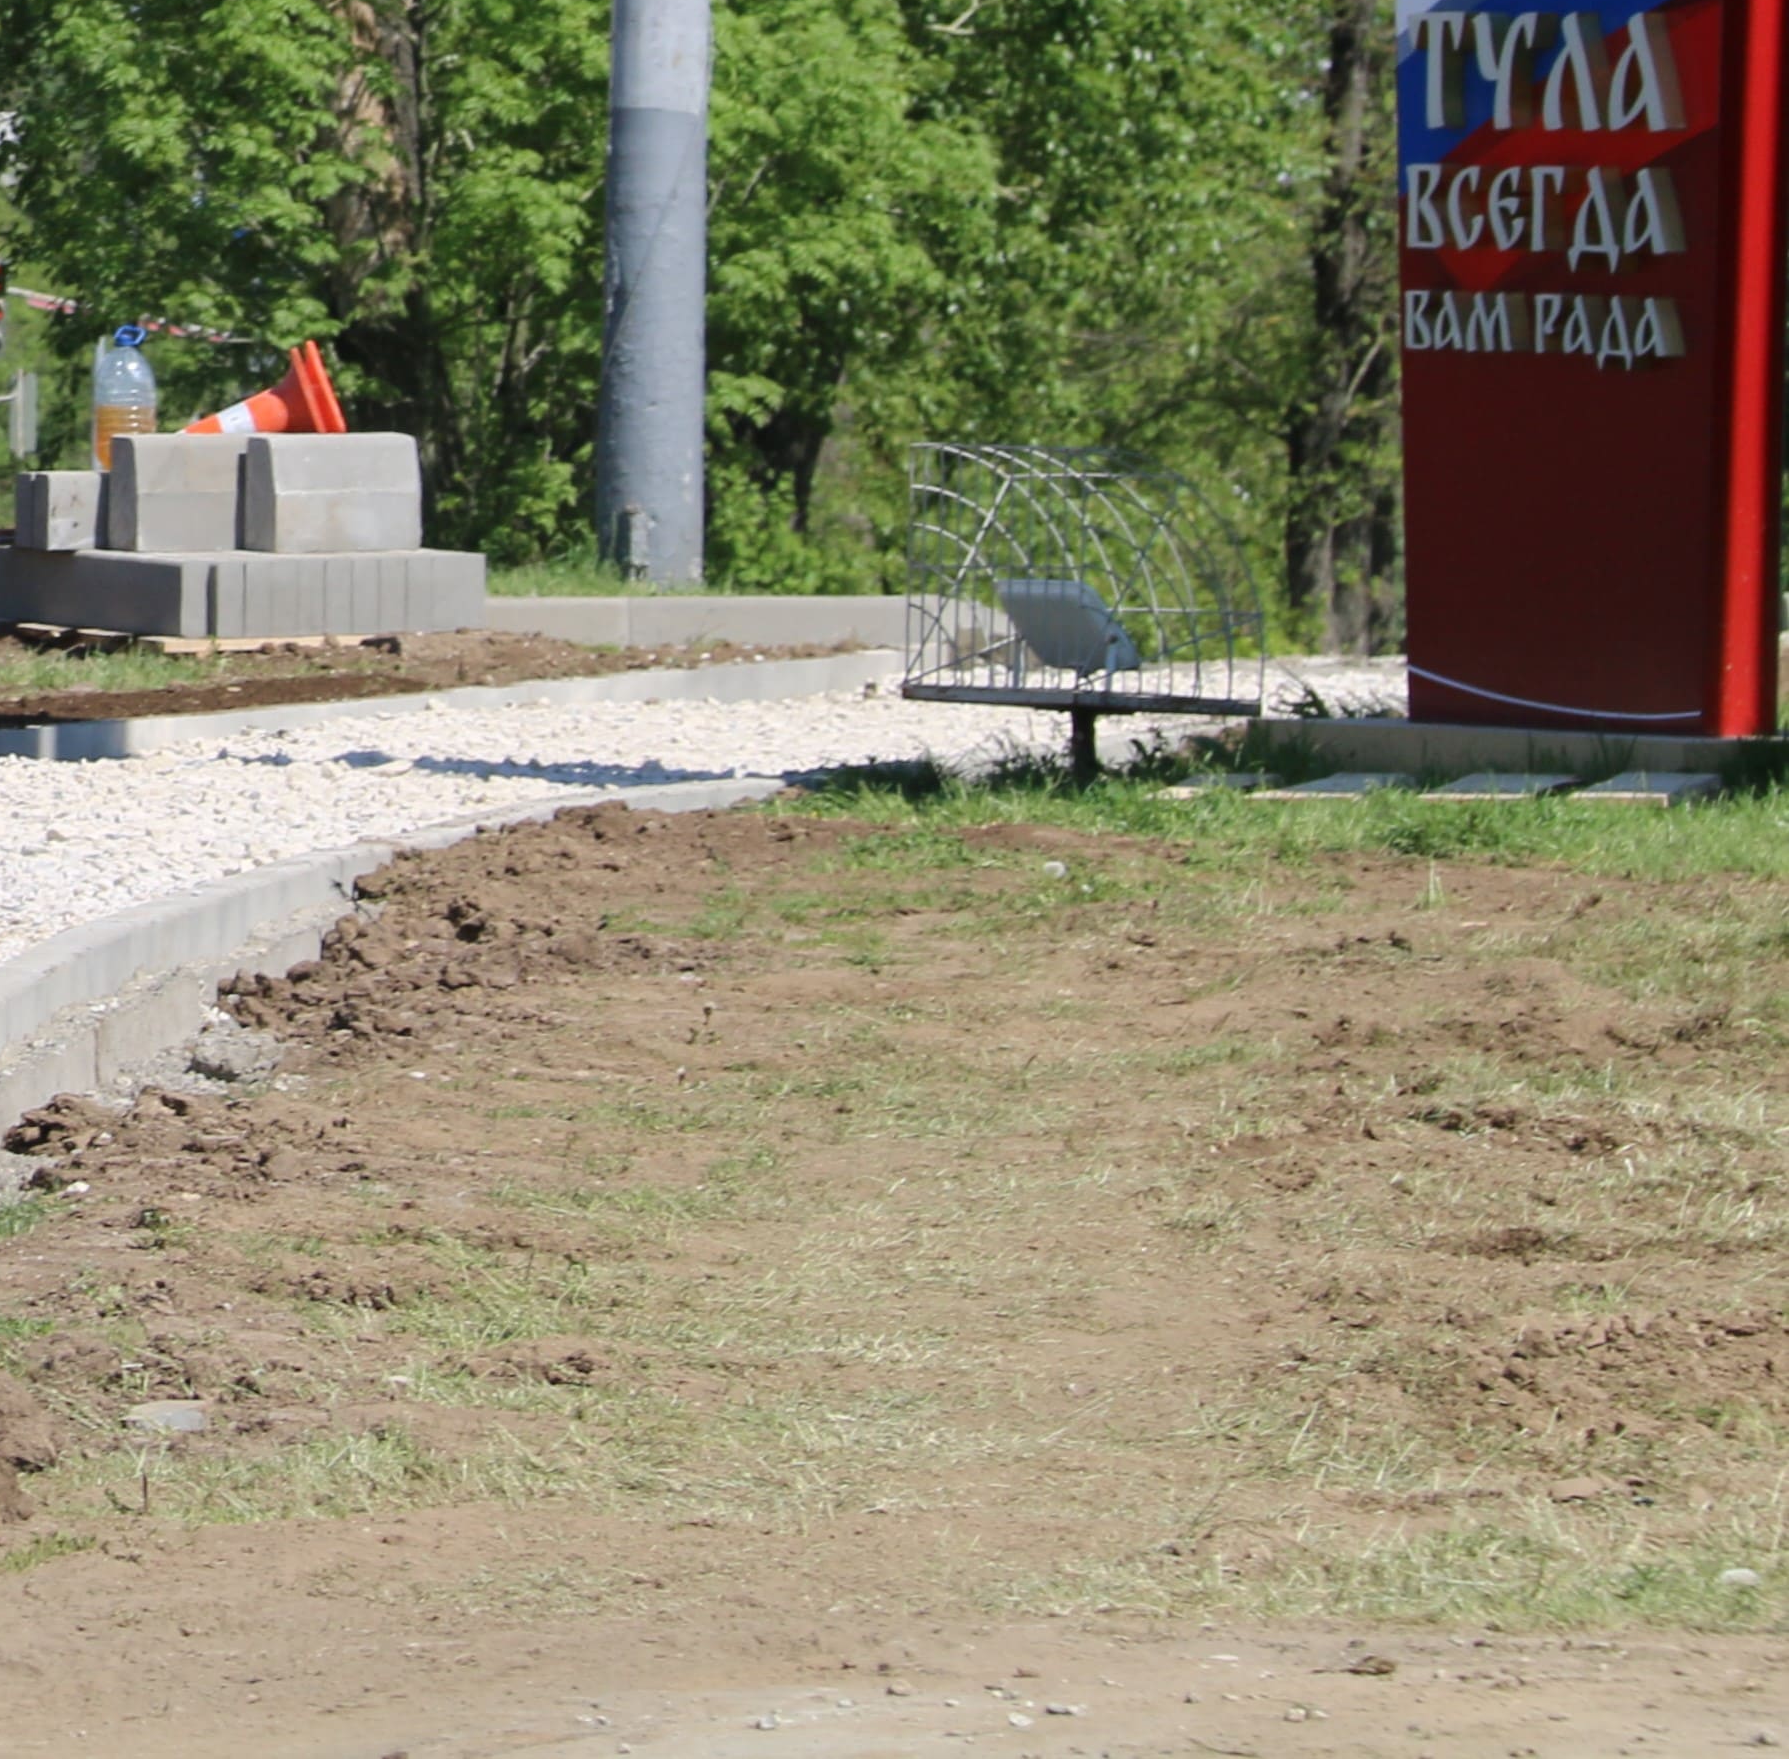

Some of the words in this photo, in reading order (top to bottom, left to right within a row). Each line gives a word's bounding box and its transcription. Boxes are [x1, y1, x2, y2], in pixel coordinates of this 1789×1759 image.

[1408, 10, 1668, 132] ТУЛА
[1406, 164, 1668, 273] ВСЕГДА
[1404, 290, 1512, 352] ВАМ
[1534, 293, 1667, 371] РАДА
